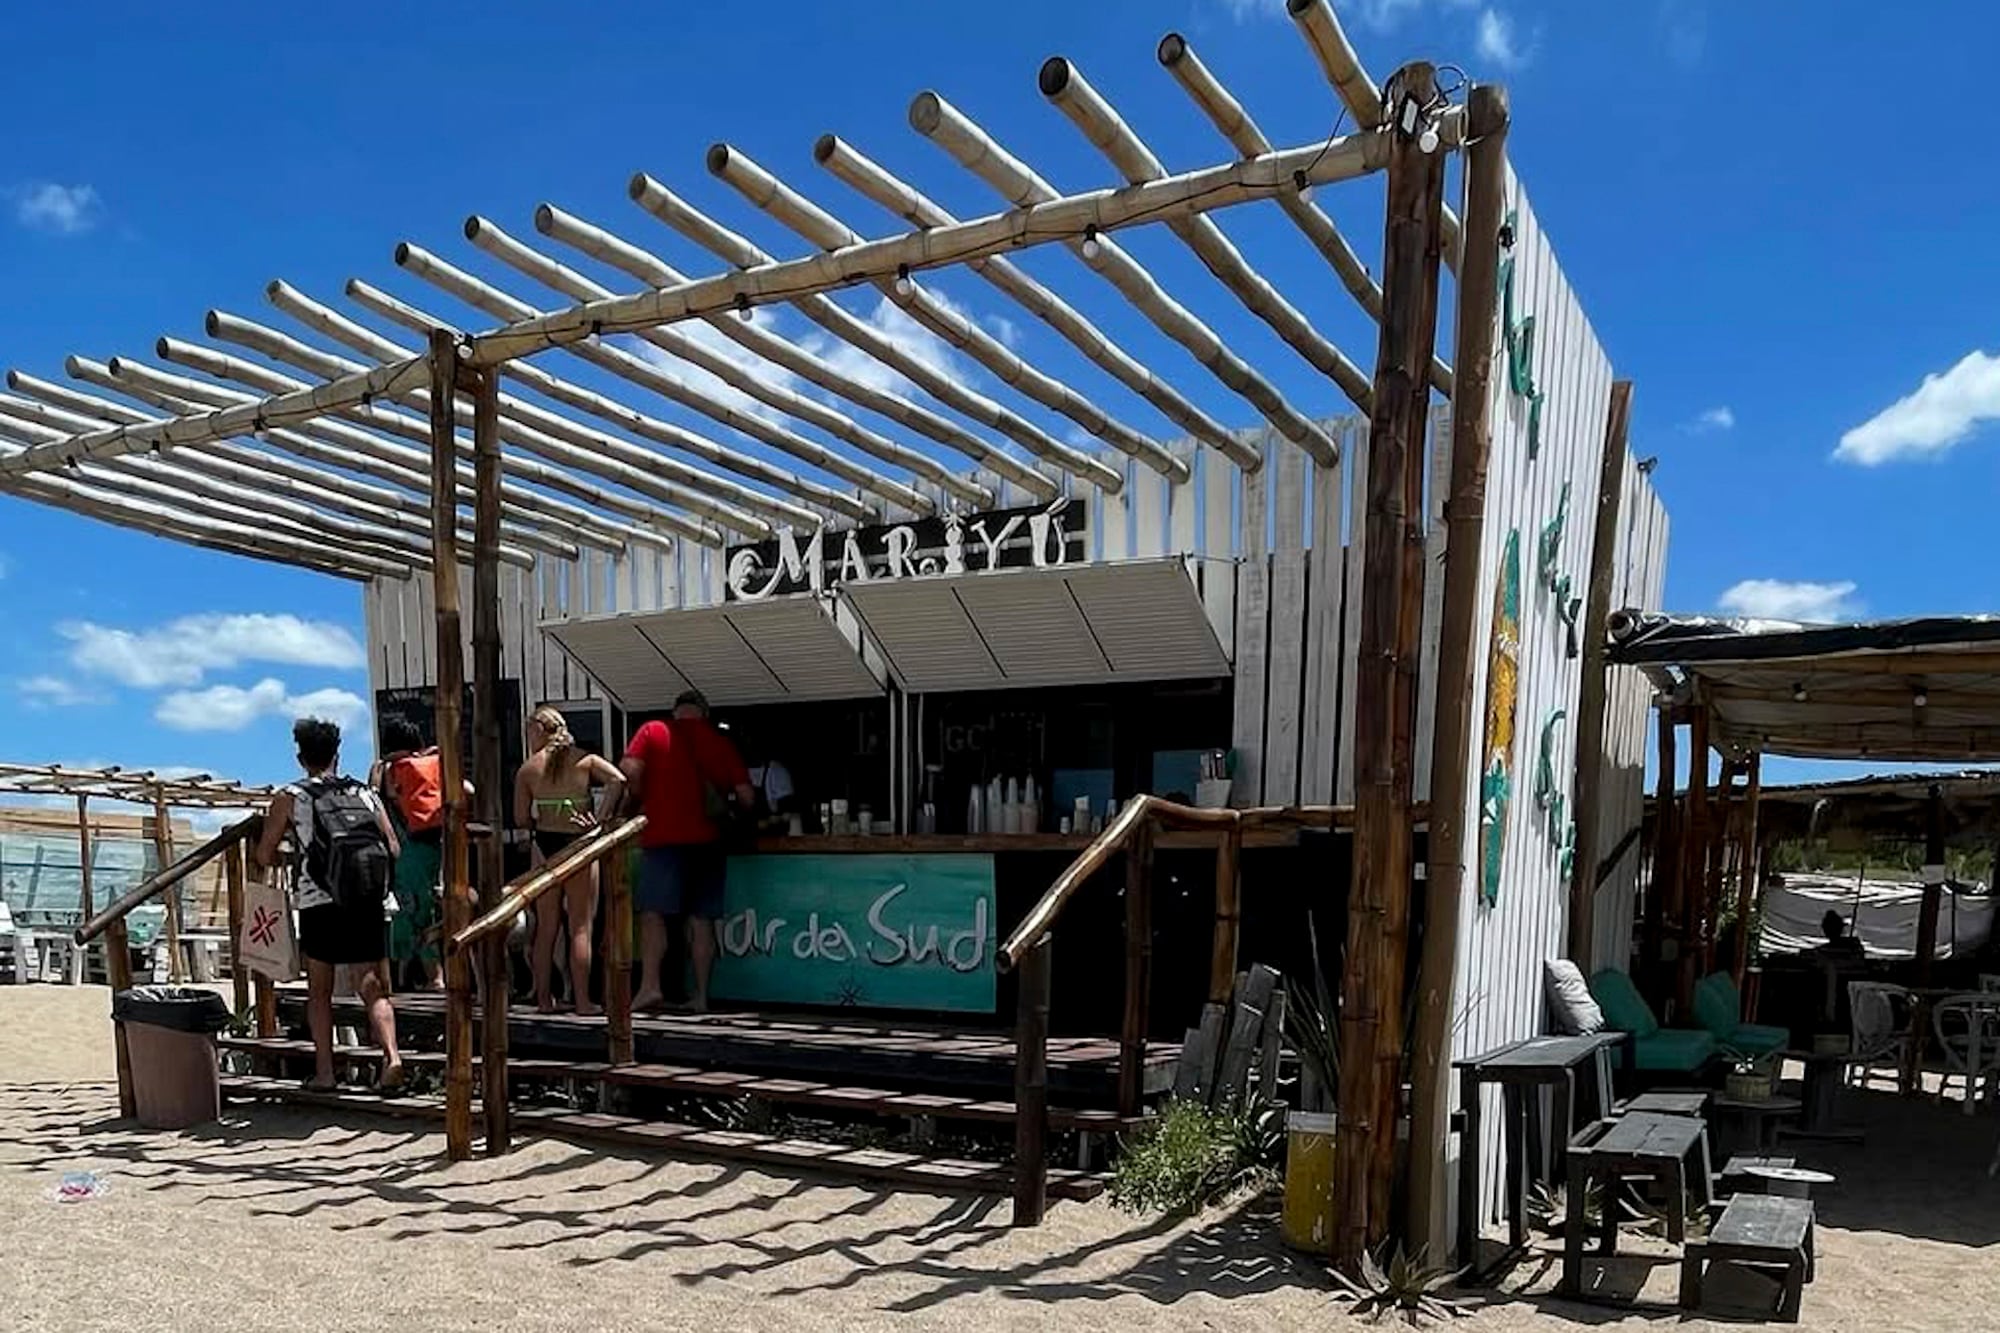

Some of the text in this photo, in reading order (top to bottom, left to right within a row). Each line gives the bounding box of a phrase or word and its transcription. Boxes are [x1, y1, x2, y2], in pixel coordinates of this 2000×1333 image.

[714, 883, 988, 972] ar del Sud
